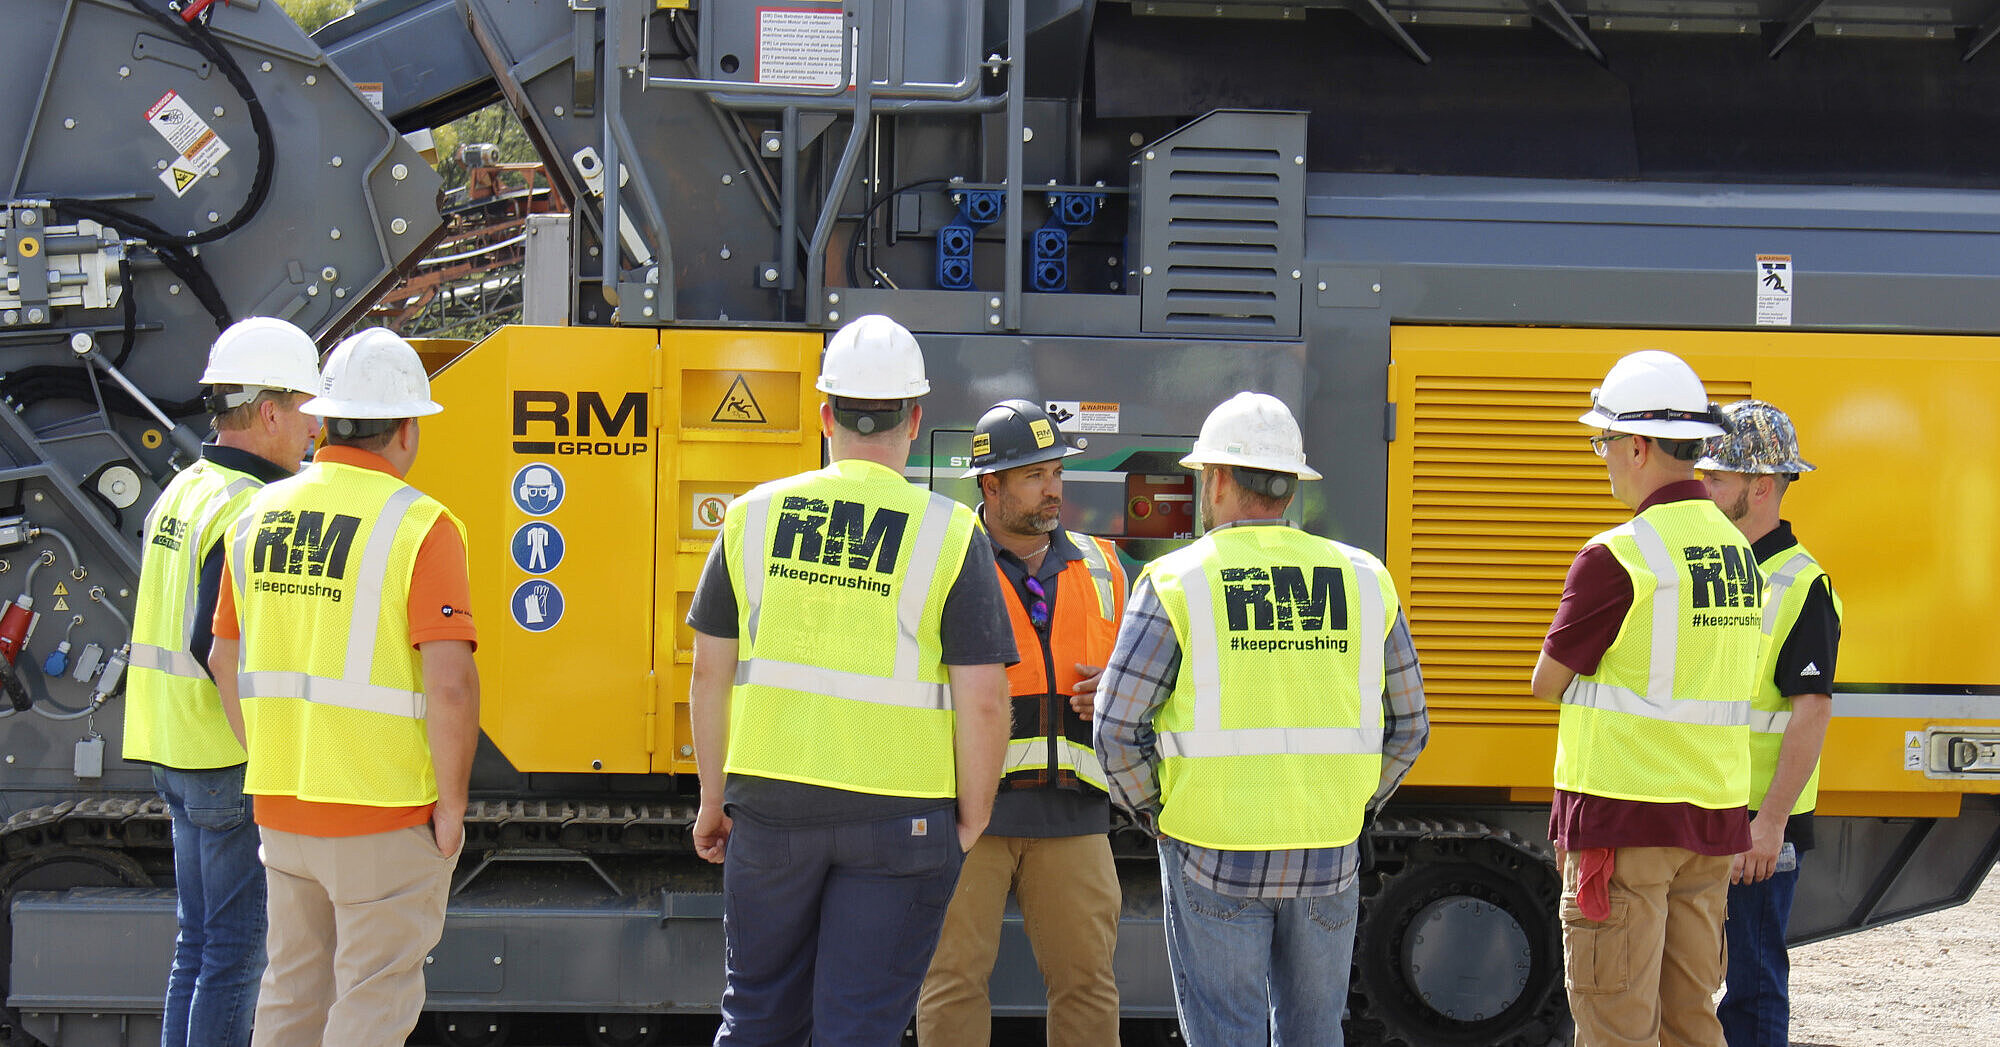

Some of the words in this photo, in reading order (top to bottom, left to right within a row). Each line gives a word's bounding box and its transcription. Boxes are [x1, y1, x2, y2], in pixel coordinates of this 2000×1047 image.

[151, 91, 174, 114] DANGER
[513, 390, 648, 437] RM
[558, 442, 648, 455] GROUP
[160, 515, 188, 539] CASE
[772, 496, 909, 574] RM
[253, 510, 362, 580] RM
[254, 578, 342, 602] #eepcrushng
[769, 564, 891, 596] #keepcrushing
[1684, 545, 1763, 608] RM
[1220, 566, 1347, 631] RM
[1231, 636, 1348, 652] #keepcrushing
